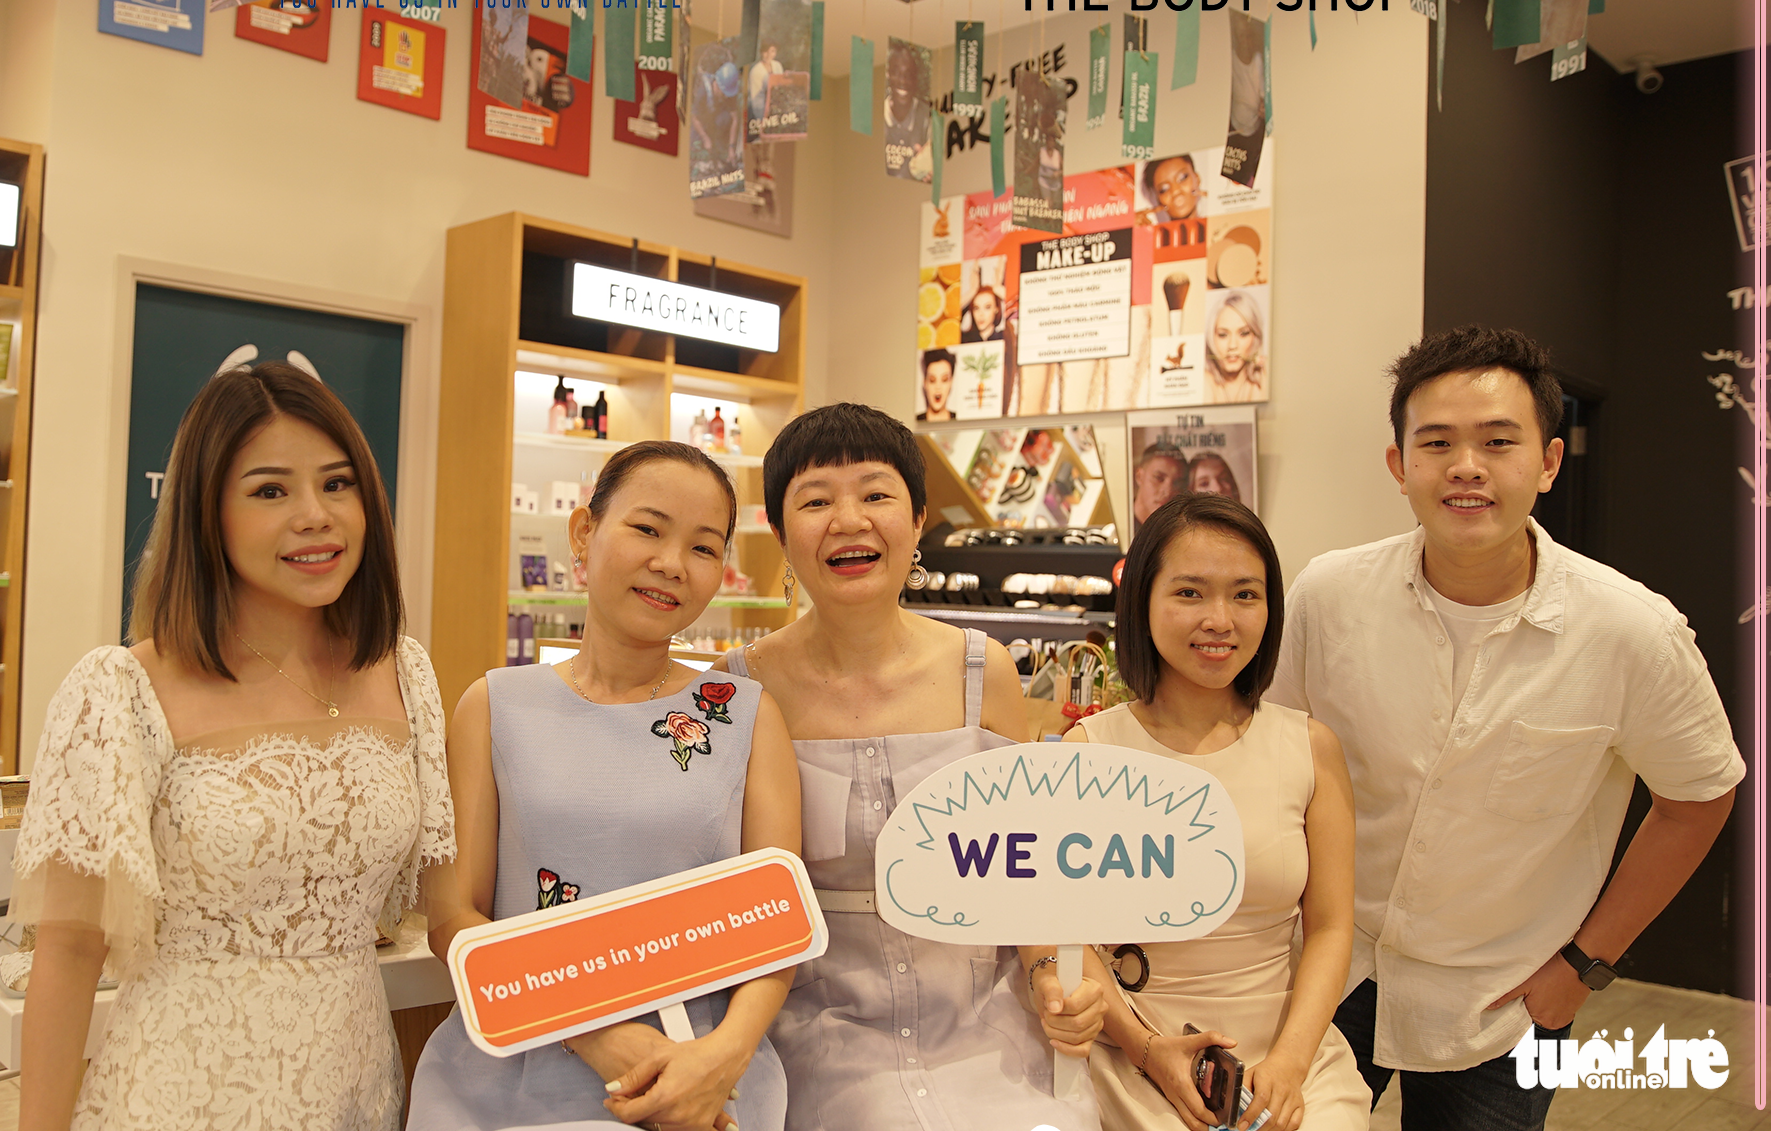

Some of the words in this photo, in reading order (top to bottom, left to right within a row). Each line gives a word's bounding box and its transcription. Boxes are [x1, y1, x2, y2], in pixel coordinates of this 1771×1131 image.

[401, 3, 441, 21] 2007
[638, 55, 673, 71] 2001
[1551, 51, 1586, 82] 1991
[952, 102, 983, 118] 1997
[1136, 82, 1150, 123] BRAZIL
[748, 114, 779, 131] OLIVE
[781, 111, 800, 126] OIL
[886, 143, 914, 158] COCOA
[1122, 144, 1154, 160] 1995
[690, 174, 720, 191] BRAZIL
[721, 169, 745, 185] NUTS
[1041, 240, 1060, 251] THE
[1060, 236, 1084, 249] BODY
[1084, 231, 1110, 246] SHOP
[1036, 240, 1117, 271] MAKE-UP
[608, 283, 749, 335] FRAGRANCE
[948, 832, 1038, 878] WE
[1056, 832, 1175, 879] CAN
[480, 980, 522, 1003] You
[525, 964, 579, 991] have
[583, 956, 607, 974] us
[609, 946, 632, 966] in
[634, 932, 680, 963] your
[685, 919, 726, 943] own
[727, 897, 792, 929] battle
